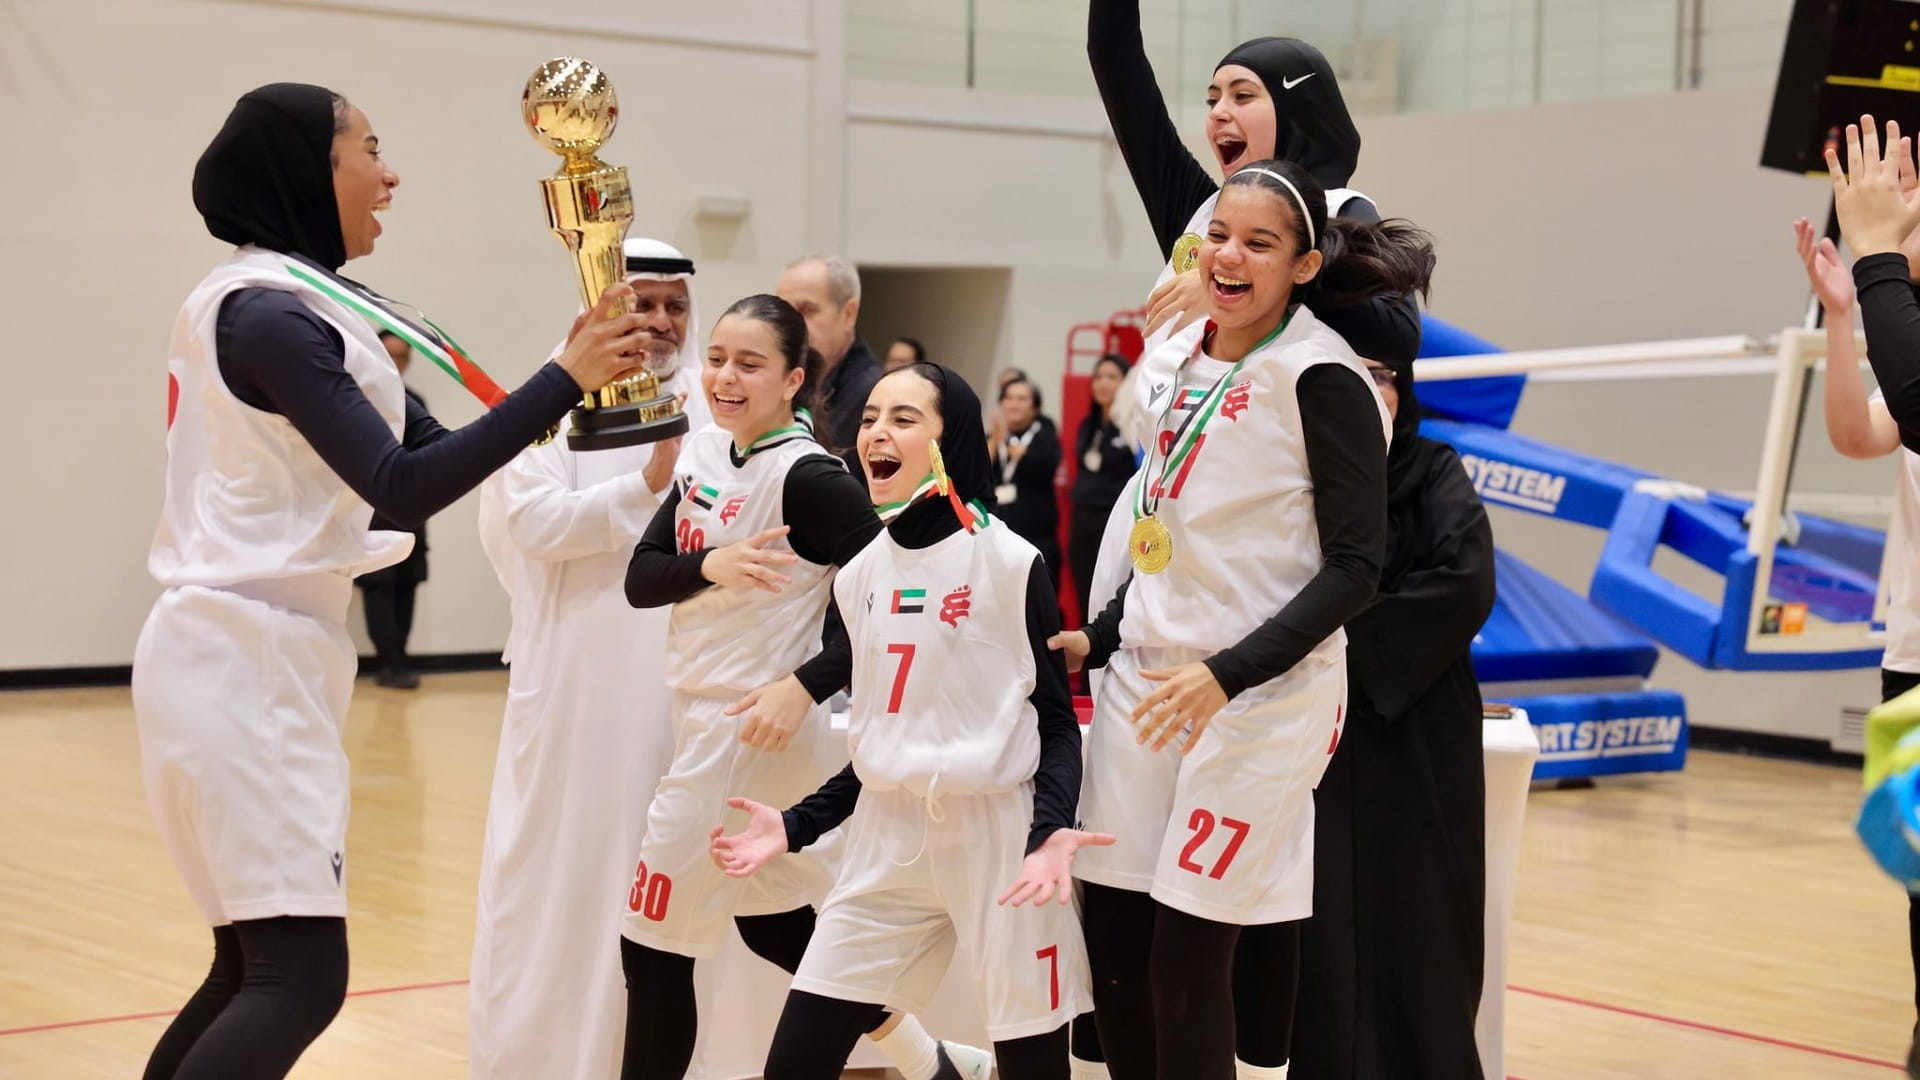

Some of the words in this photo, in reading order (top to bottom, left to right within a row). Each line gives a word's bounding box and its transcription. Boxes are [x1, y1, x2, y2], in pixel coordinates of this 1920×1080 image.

[1461, 454, 1566, 505] SYSTEM
[887, 643, 916, 714] 7
[1178, 808, 1251, 880] 27
[629, 860, 672, 922] 30
[1036, 944, 1059, 1011] 7
